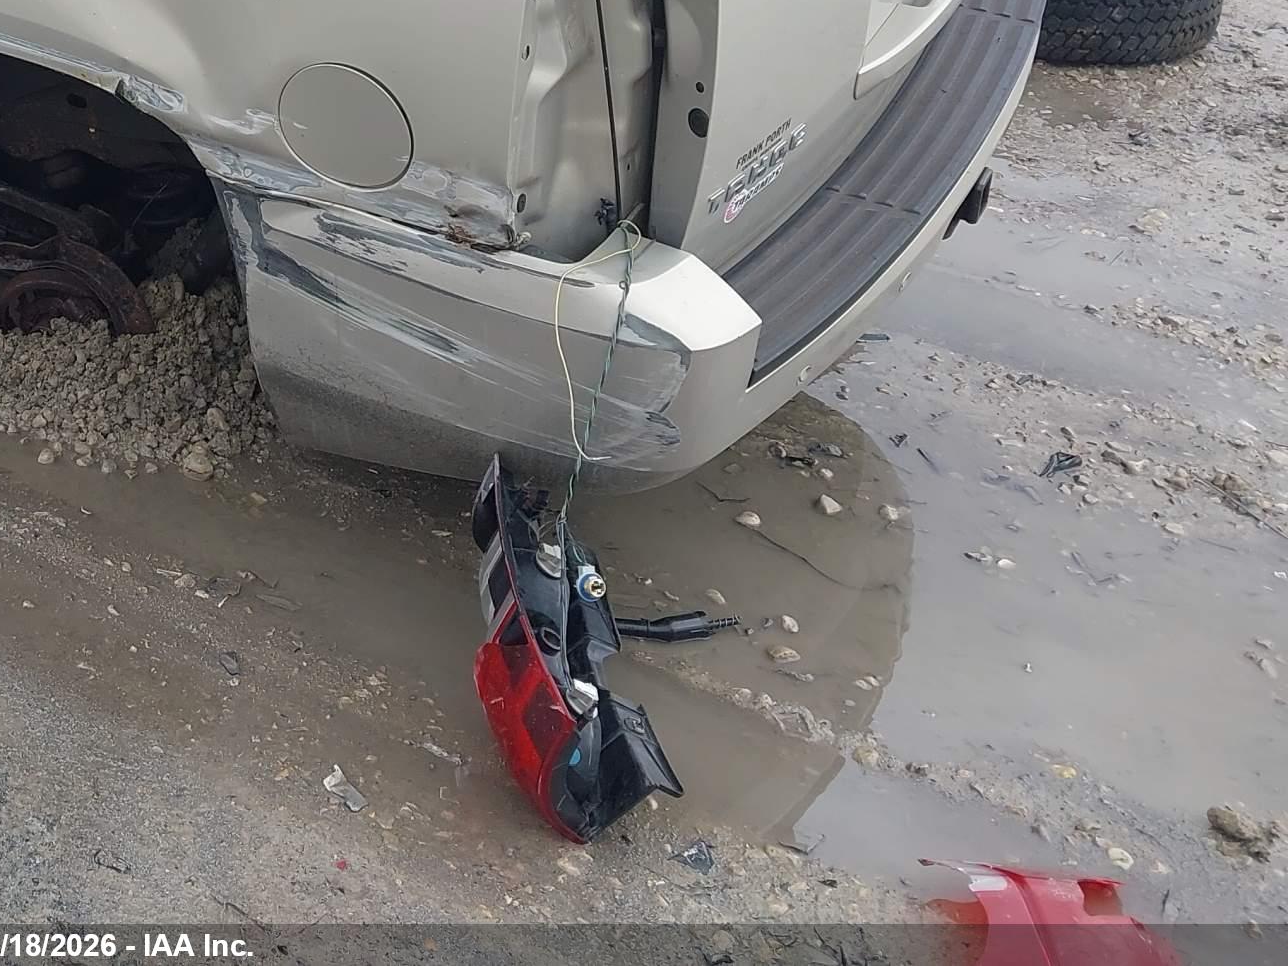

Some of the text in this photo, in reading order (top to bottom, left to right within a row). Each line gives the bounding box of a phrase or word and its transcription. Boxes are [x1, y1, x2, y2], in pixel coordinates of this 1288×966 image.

[707, 122, 807, 214] TAHOE
[736, 137, 765, 170] FRANK
[764, 117, 793, 147] PORTH
